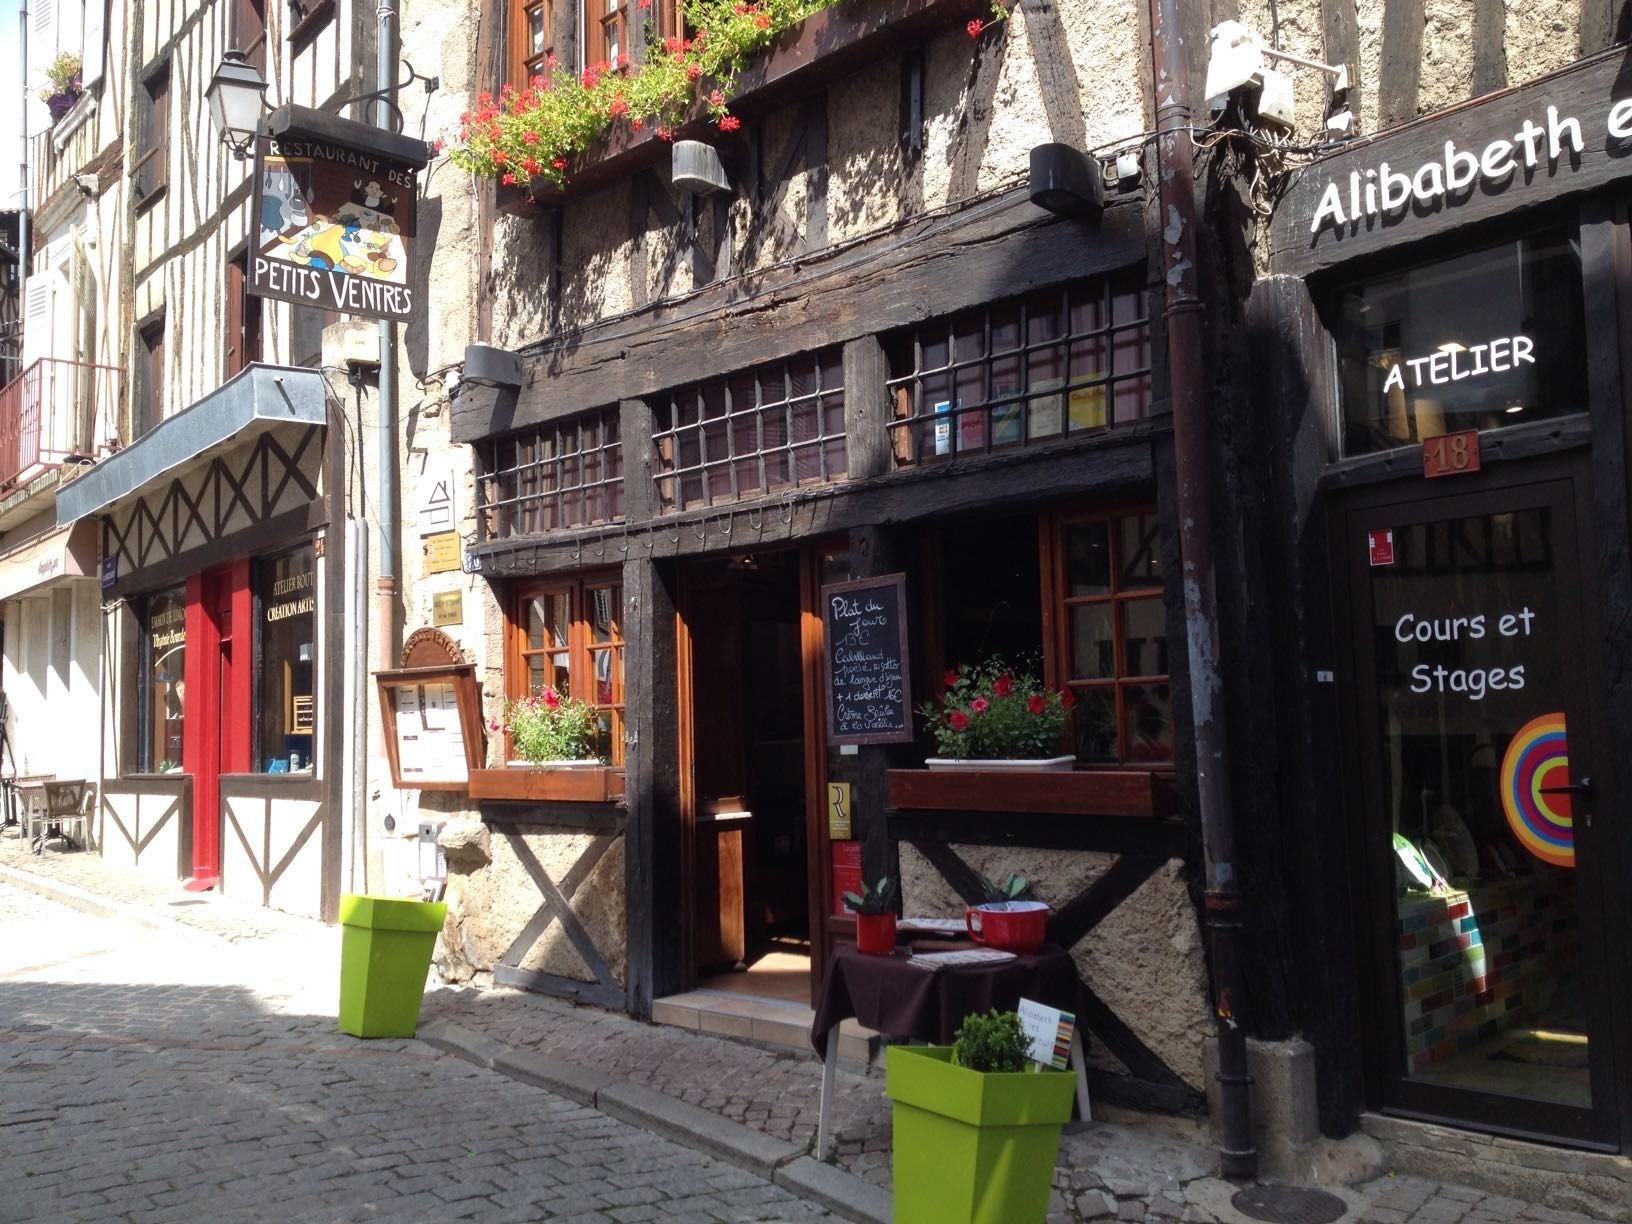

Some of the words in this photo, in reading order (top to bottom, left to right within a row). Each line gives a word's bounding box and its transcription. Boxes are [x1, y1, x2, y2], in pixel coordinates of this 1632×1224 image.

[270, 140, 380, 173] RESTAURANT
[388, 169, 412, 189] DES
[1311, 105, 1585, 232] Alibabeth
[255, 257, 320, 299] PETITS
[328, 271, 412, 314] VENTRES
[1383, 335, 1536, 393] ATELIER
[1433, 435, 1469, 471] 18
[273, 577, 296, 597] ATELIER
[832, 596, 862, 620] Plat
[865, 599, 884, 612] du
[1394, 612, 1486, 643] Cours
[1498, 606, 1535, 637] et
[835, 647, 884, 664] Cabillaud
[834, 676, 846, 686] de
[836, 693, 844, 702] +
[845, 691, 851, 701] 1
[1410, 663, 1526, 700] Stages
[852, 721, 863, 730] la
